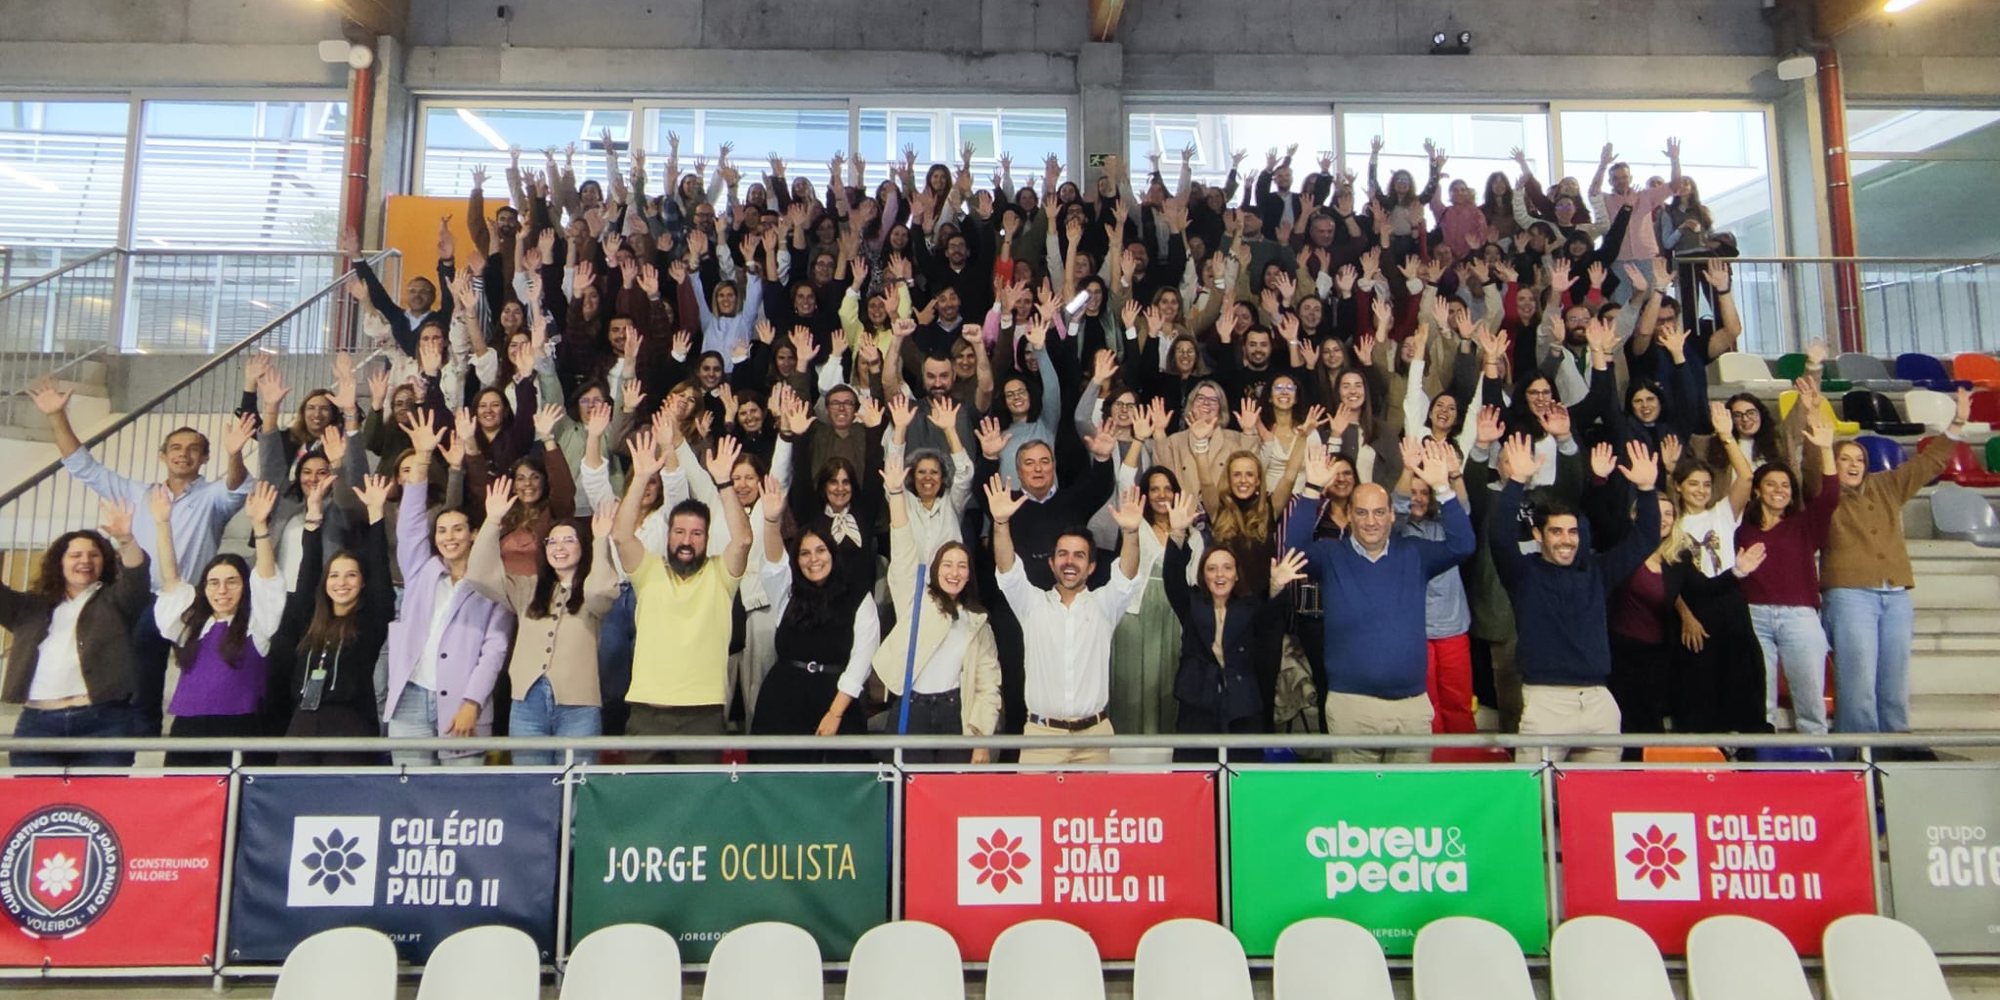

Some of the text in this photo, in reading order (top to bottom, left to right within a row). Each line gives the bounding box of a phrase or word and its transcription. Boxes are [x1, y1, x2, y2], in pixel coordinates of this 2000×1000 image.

[391, 810, 504, 846] COLÉGIO
[1053, 809, 1163, 844] COLÉGIO
[1707, 807, 1816, 841] COLÉGIO
[1927, 825, 1987, 845] grupo
[0, 811, 117, 915] CLUBE DESPORTIVO COLÉGIO JOÃO PAULO II
[129, 858, 209, 870] CONSTRUINDO
[388, 846, 456, 876] JOÃO
[721, 843, 856, 880] OCULISTA
[1054, 845, 1119, 873] JOÃO
[1710, 842, 1775, 871] JOÃO
[129, 870, 179, 881] VALORES
[1055, 875, 1165, 903] PAULO II
[1326, 857, 1467, 899] pedra
[1711, 873, 1822, 900] PAULO II
[387, 878, 500, 907] PAULO II
[26, 915, 81, 932] VOLEIBOL
